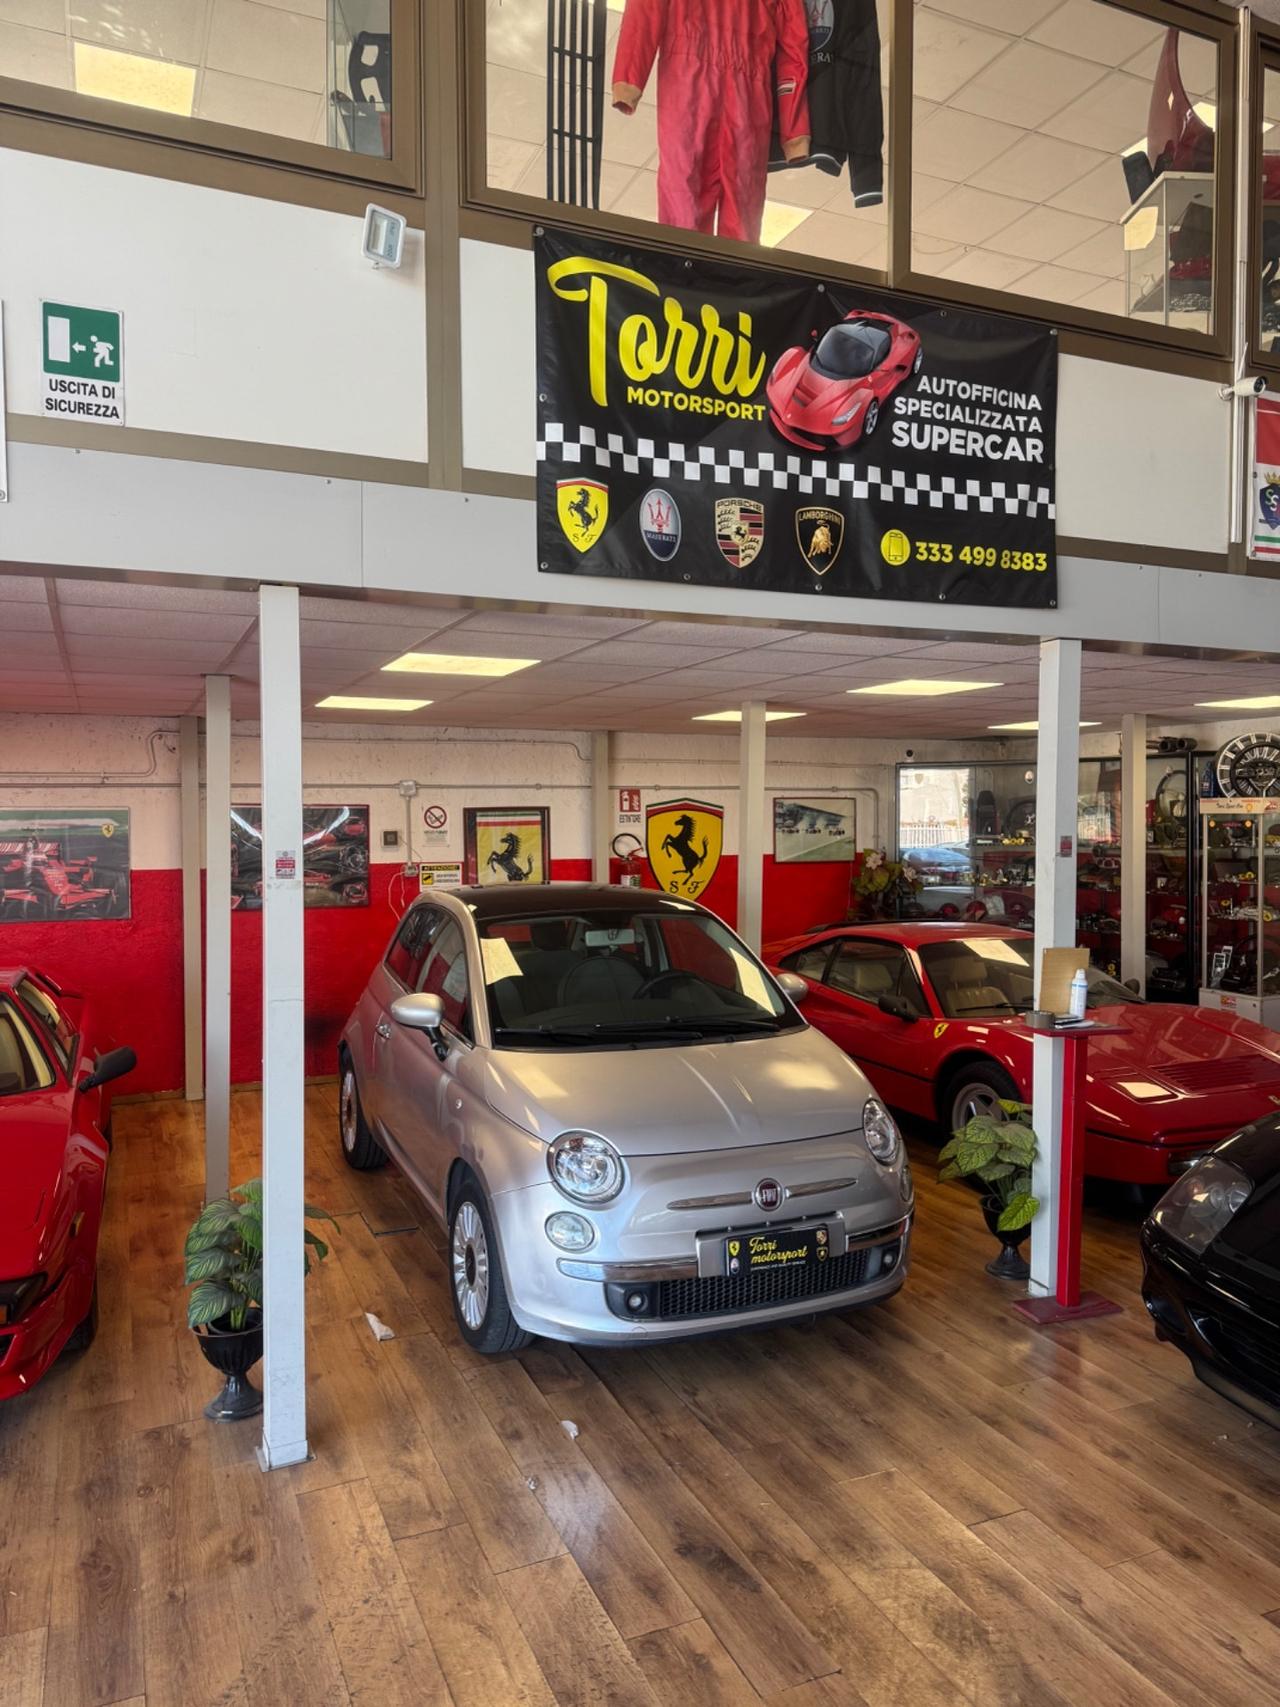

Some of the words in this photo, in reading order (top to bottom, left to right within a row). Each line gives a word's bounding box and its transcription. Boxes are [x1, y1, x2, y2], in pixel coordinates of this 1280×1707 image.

[547, 256, 767, 407] Torri
[49, 378, 98, 397] USCITA
[102, 385, 115, 399] DI
[916, 375, 1042, 411] AUTOFFICINA
[45, 397, 120, 419] SICUREZZA
[627, 386, 766, 421] MOTORSPORT
[894, 397, 1043, 433] SPECIALIZZATA
[891, 420, 1044, 464] SUPERCAR
[717, 499, 762, 513] PORSCHE
[799, 510, 841, 525] LAMBORGHINI
[915, 541, 953, 563] 333
[959, 546, 996, 567] 499
[1000, 550, 1047, 572] 8383
[669, 880, 679, 894] S
[748, 1236, 777, 1254] Torri
[750, 1245, 808, 1264] motorsport
